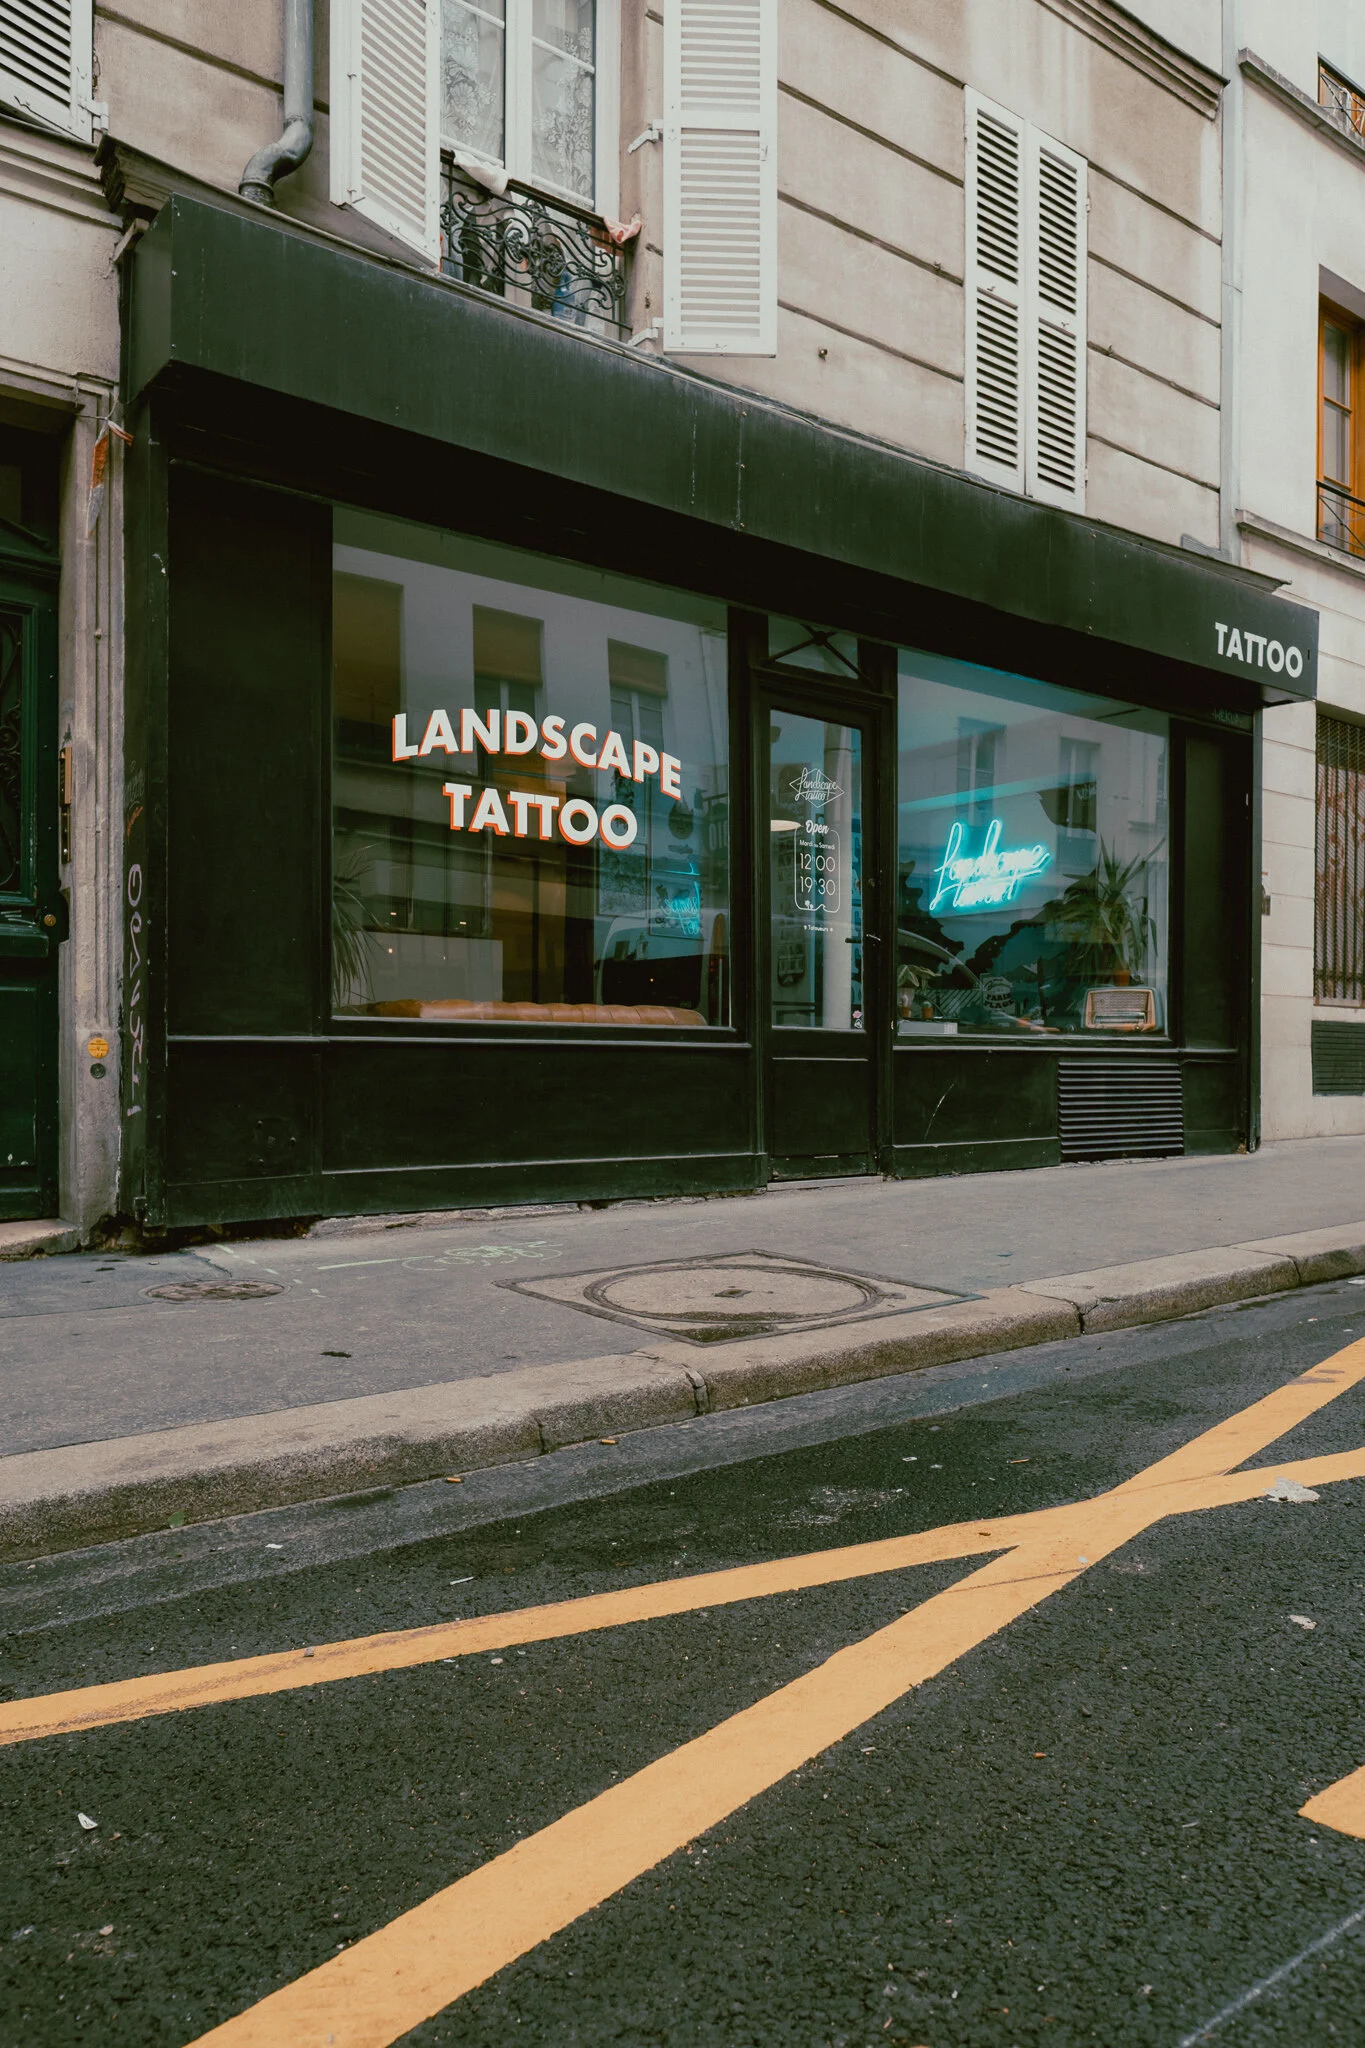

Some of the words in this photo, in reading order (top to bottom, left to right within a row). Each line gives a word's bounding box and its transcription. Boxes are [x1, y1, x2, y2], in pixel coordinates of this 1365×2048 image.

[1214, 622, 1304, 679] TATTOO
[391, 708, 682, 801] LANDSCAPE
[442, 781, 639, 850] TATTOO
[805, 819, 830, 836] Open
[799, 839, 813, 848] Mardi
[818, 841, 836, 851] Samedi
